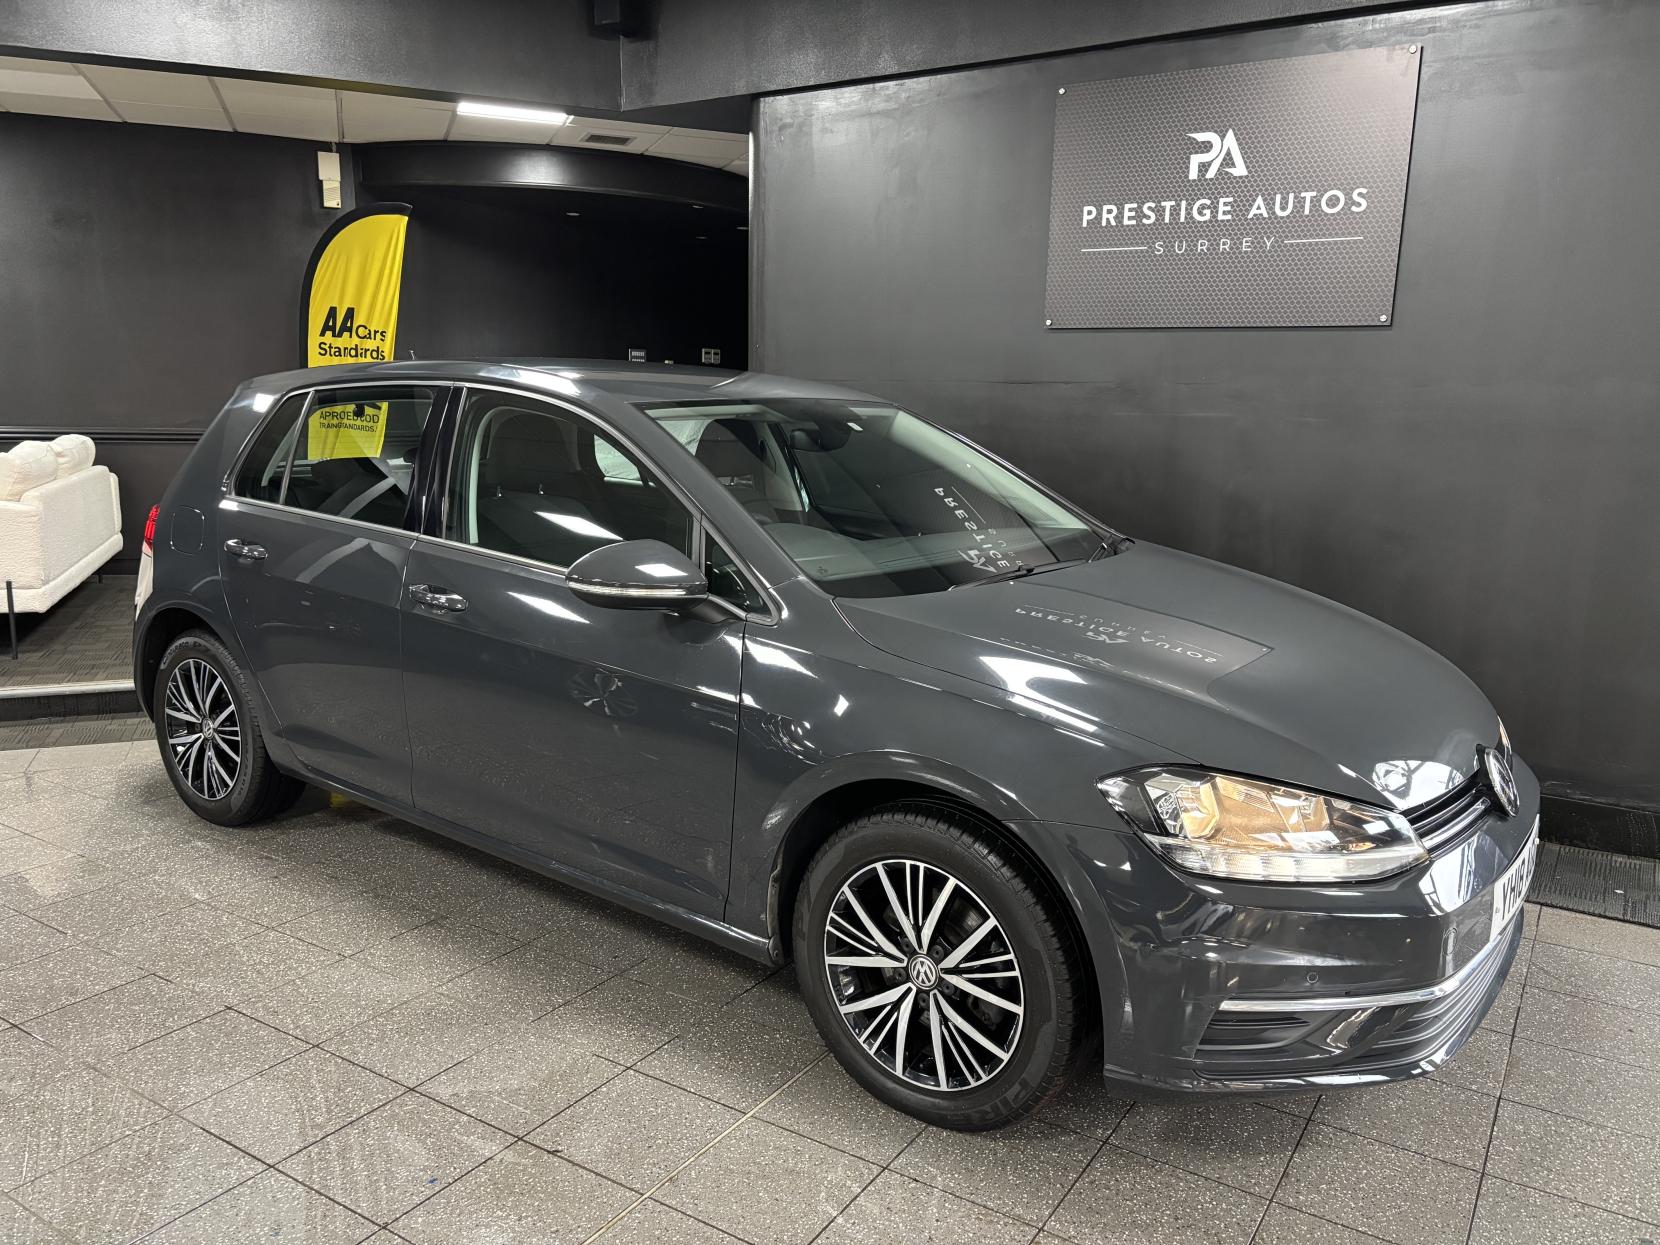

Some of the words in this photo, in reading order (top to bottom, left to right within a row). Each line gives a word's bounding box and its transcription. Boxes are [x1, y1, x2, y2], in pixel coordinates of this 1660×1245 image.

[1186, 128, 1249, 181] PA
[1081, 197, 1234, 228] PRESTIGE
[1247, 187, 1368, 219] AUTOS
[1154, 236, 1276, 255] SURREY
[318, 306, 355, 339] AA
[355, 324, 387, 342] Cars
[318, 341, 386, 361] Standards
